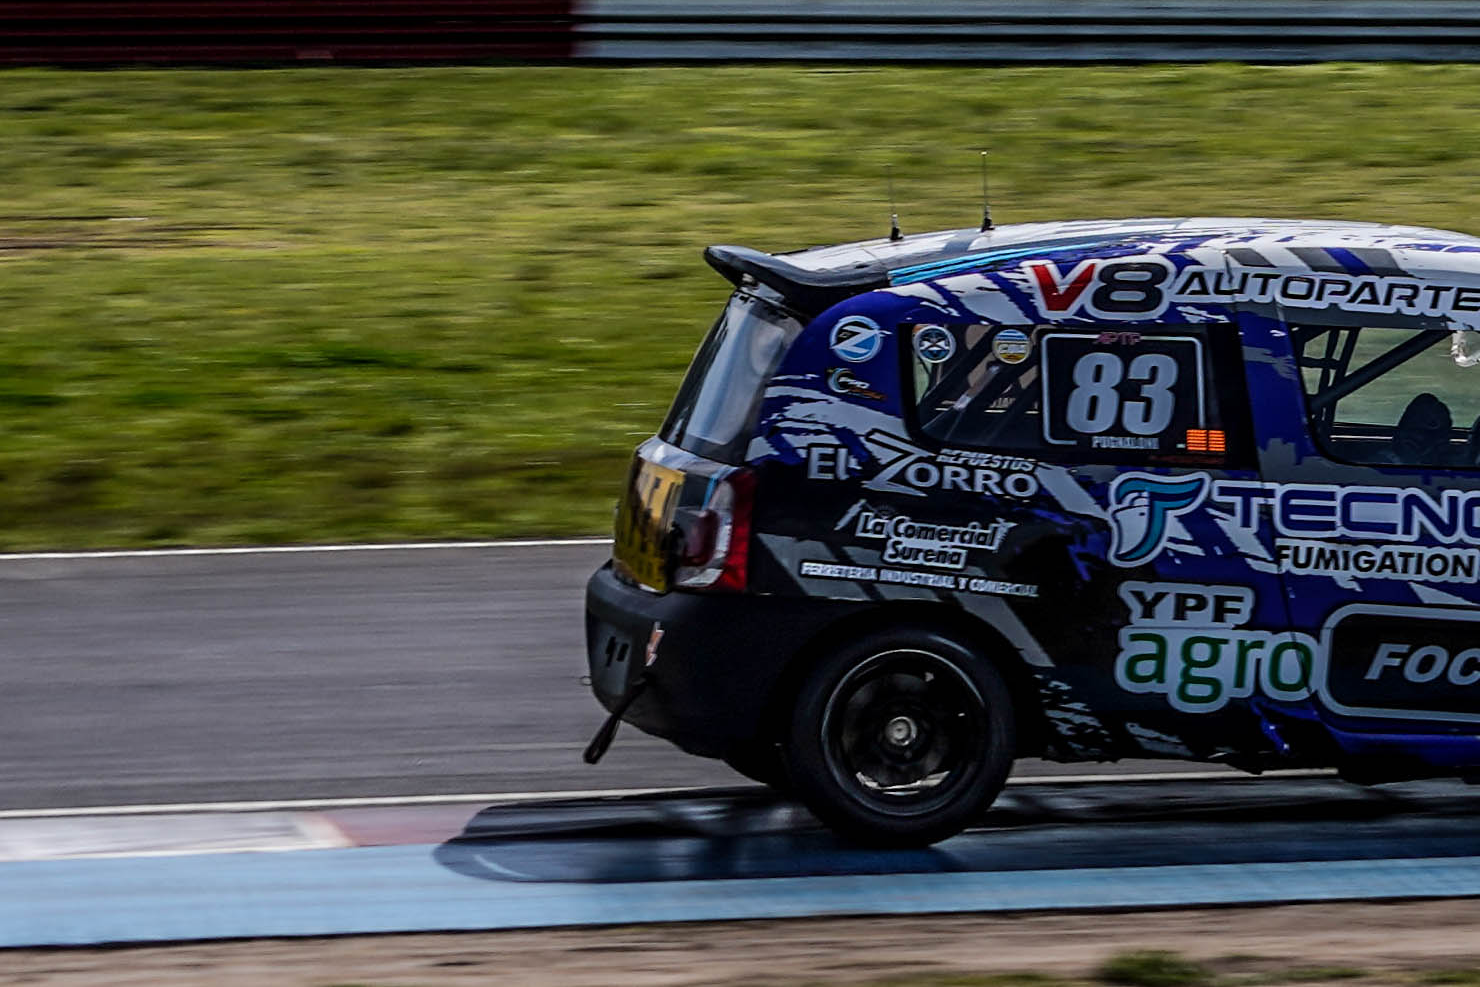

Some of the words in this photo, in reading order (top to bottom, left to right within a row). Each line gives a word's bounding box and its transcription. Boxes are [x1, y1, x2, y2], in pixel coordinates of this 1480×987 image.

[1031, 261, 1170, 313] V8
[1065, 352, 1179, 436] 83
[861, 432, 1040, 498] ZORRO
[935, 447, 1038, 472] REPUESTOS
[860, 513, 888, 535] La
[892, 515, 998, 548] Comercial
[1275, 544, 1475, 580] FUMIGATION
[1129, 590, 1245, 623] YPF
[1124, 632, 1313, 704] agro
